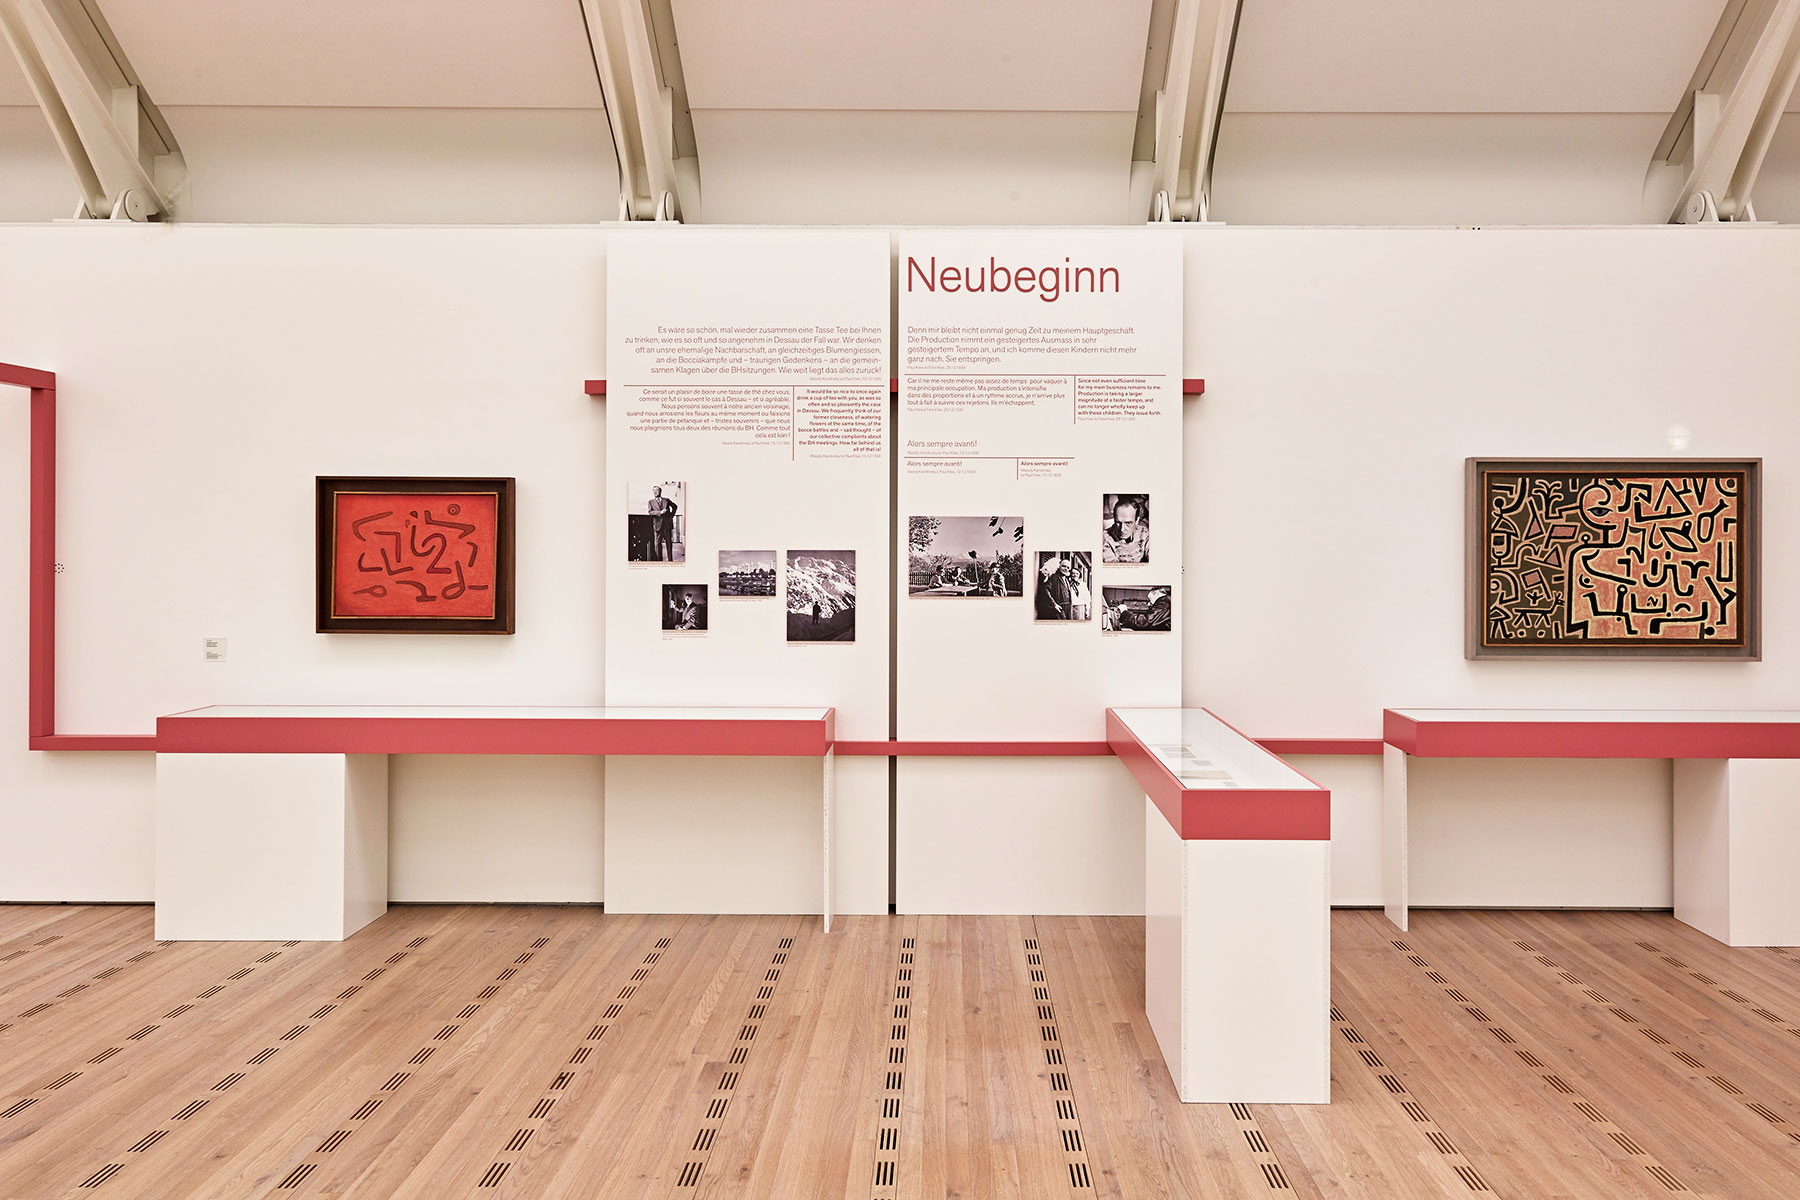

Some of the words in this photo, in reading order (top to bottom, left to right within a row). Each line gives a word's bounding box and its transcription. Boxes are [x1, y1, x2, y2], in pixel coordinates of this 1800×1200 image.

[908, 257, 1119, 302] Neubeginn
[1004, 328, 1028, 336] genug
[728, 336, 765, 346] angenehm
[996, 336, 1040, 346] gesteigertes
[677, 346, 714, 356] ehemalige
[778, 346, 824, 356] gleichzeitiges
[907, 345, 954, 355] gesteigertem
[956, 345, 979, 355] Tempo
[750, 356, 781, 366] traurigen
[852, 356, 881, 366] gemein-
[907, 357, 924, 365] ganz
[676, 366, 700, 376] Klagen
[808, 366, 824, 376] liegt
[926, 442, 953, 450] sempre
